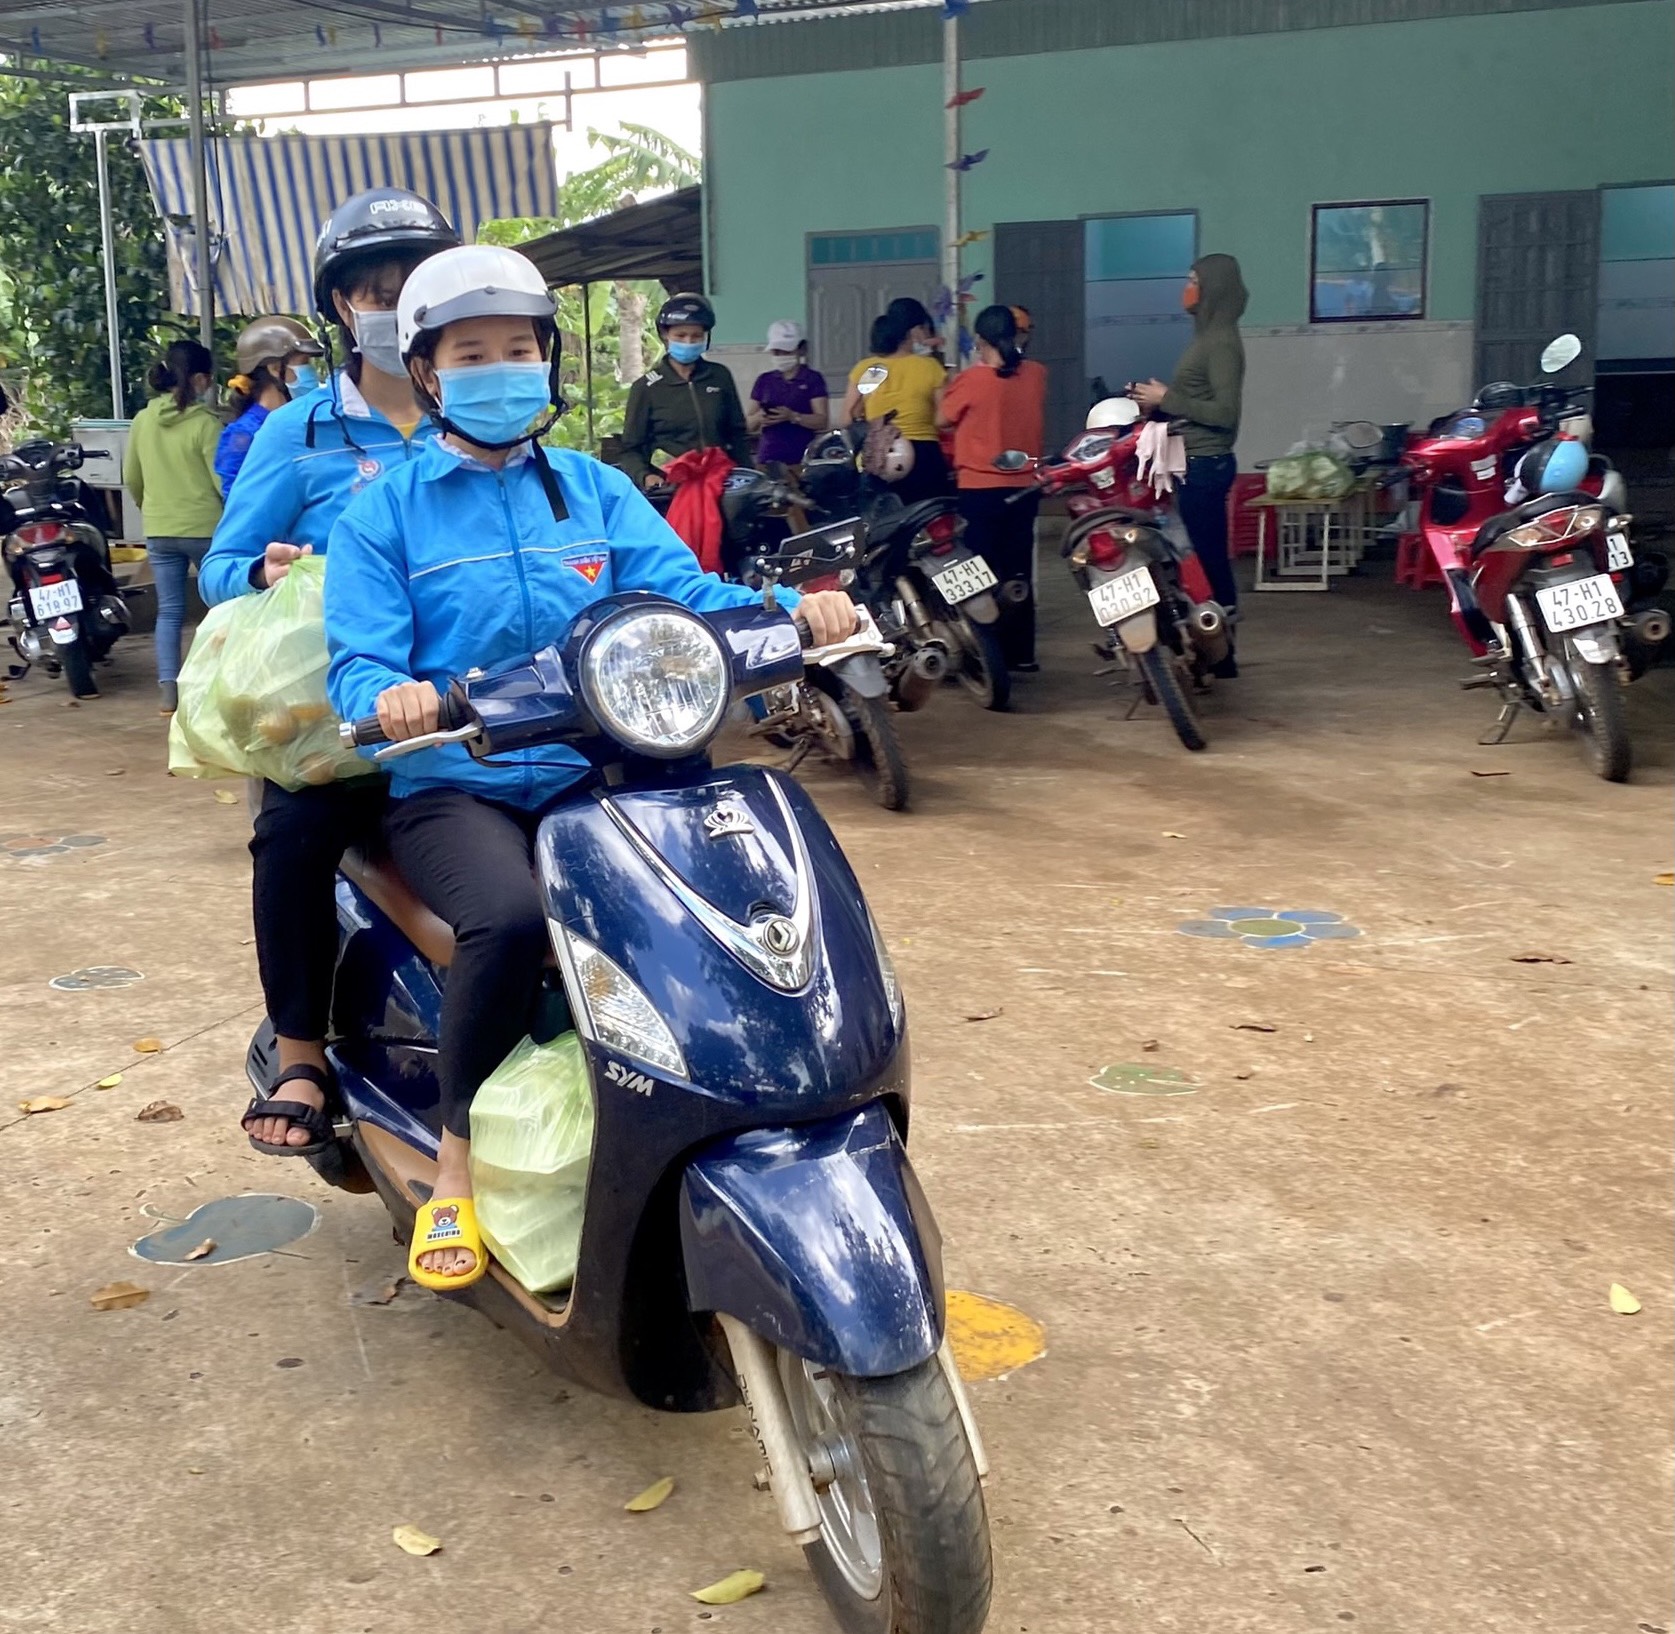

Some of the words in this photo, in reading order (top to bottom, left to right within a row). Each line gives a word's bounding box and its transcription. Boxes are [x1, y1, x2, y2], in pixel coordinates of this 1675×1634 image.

[943, 560, 980, 585] 47-H1
[946, 570, 993, 601] 333.17
[1100, 573, 1141, 602] 47-H1
[1552, 580, 1602, 607] 47-H1
[1552, 597, 1618, 627] 430.28
[604, 1060, 655, 1097] SYM
